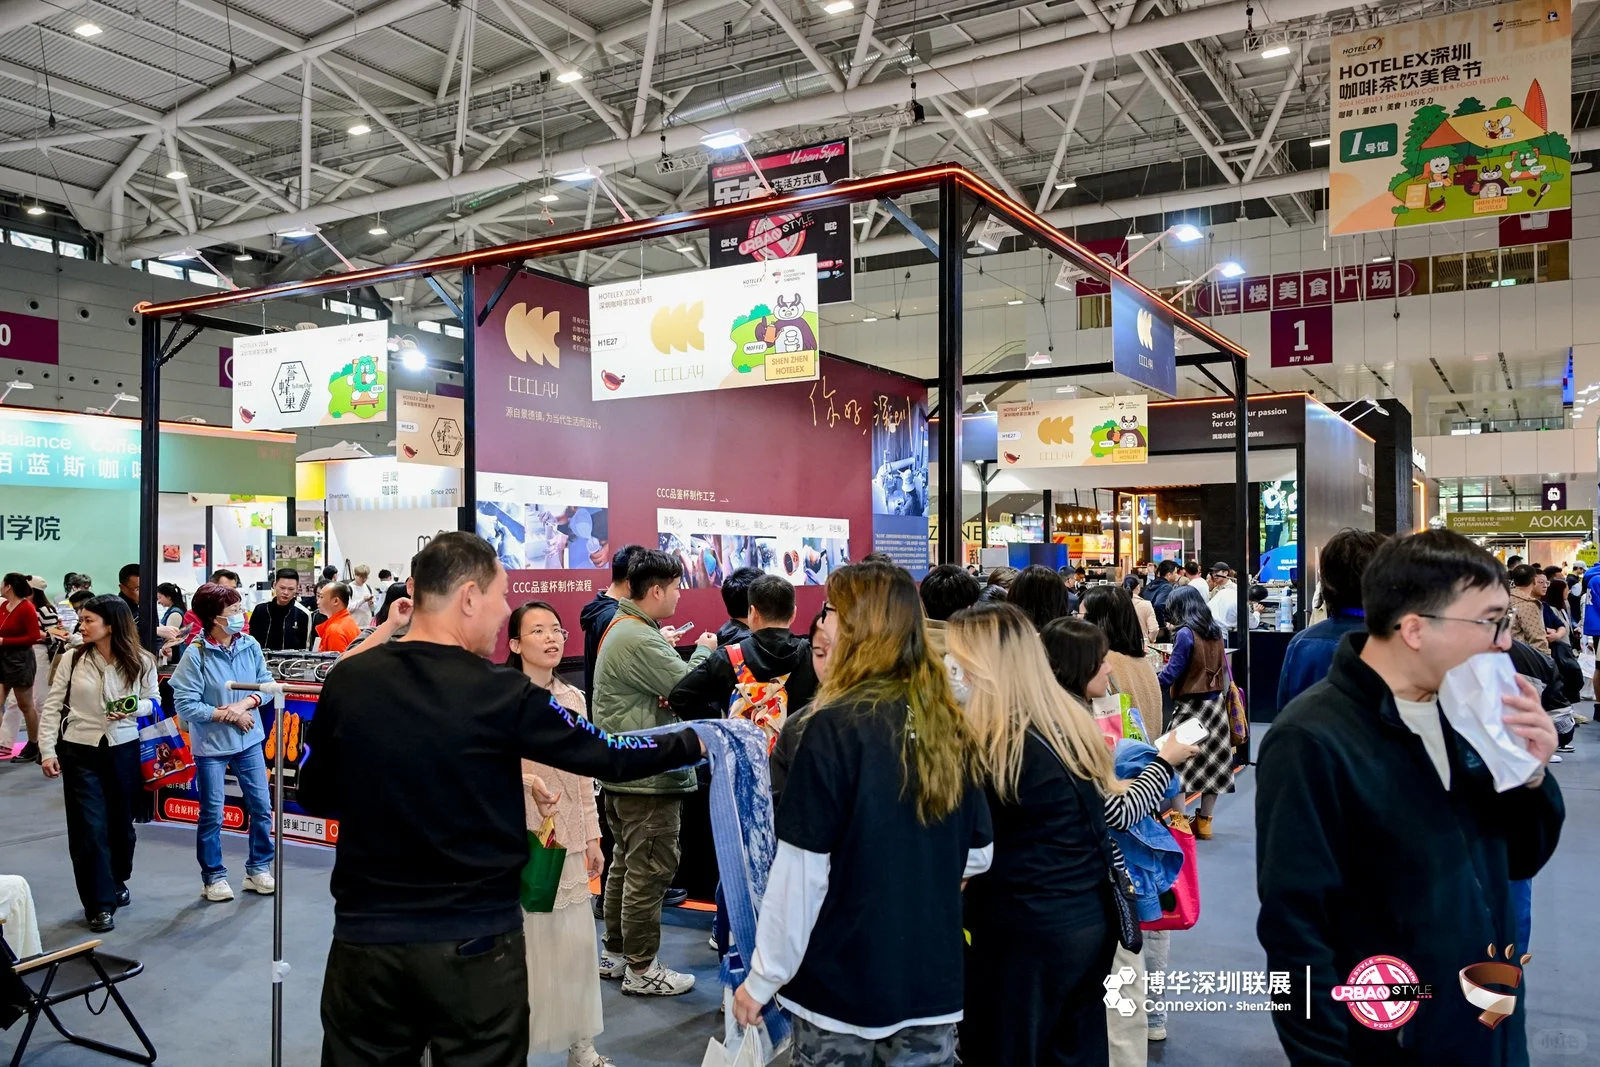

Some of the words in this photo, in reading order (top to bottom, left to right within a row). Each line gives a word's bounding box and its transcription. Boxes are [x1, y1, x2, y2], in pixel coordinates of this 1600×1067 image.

[1342, 43, 1378, 55] HOTELEX
[1339, 42, 1472, 80] HOTELEX深圳
[1339, 60, 1483, 101] 咖啡茶饮美食节
[1421, 84, 1448, 94] COFFEE
[1456, 80, 1478, 89] FOOD
[1479, 74, 1510, 85] FESTIVAL
[1386, 101, 1401, 112] 美食
[1410, 96, 1434, 108] 巧克力
[1364, 141, 1389, 155] 号馆
[773, 171, 823, 190] 生活方式展
[782, 212, 815, 233] STYLE
[598, 291, 624, 301] HOTELEX
[625, 288, 640, 297] 2024
[1221, 269, 1393, 306] 三楼美食广场
[597, 337, 618, 347] H1E27
[1293, 319, 1309, 351] 1
[745, 344, 765, 352] MOFFEE
[771, 357, 790, 366] SHEN
[790, 354, 809, 364] ZHEN
[775, 365, 805, 376] HOTELEX
[1211, 411, 1237, 420] Satisfy
[1257, 407, 1288, 418] passion
[1211, 420, 1223, 428] for
[430, 488, 445, 496] Since
[444, 487, 458, 495] 2021
[656, 487, 716, 503] CCC品鉴杯制作工艺
[0, 514, 61, 541] 学院
[1528, 515, 1587, 528] AOKKA
[512, 579, 593, 594] CCC品鉴杯制作流程
[282, 818, 324, 836] 蜂巢工厂店
